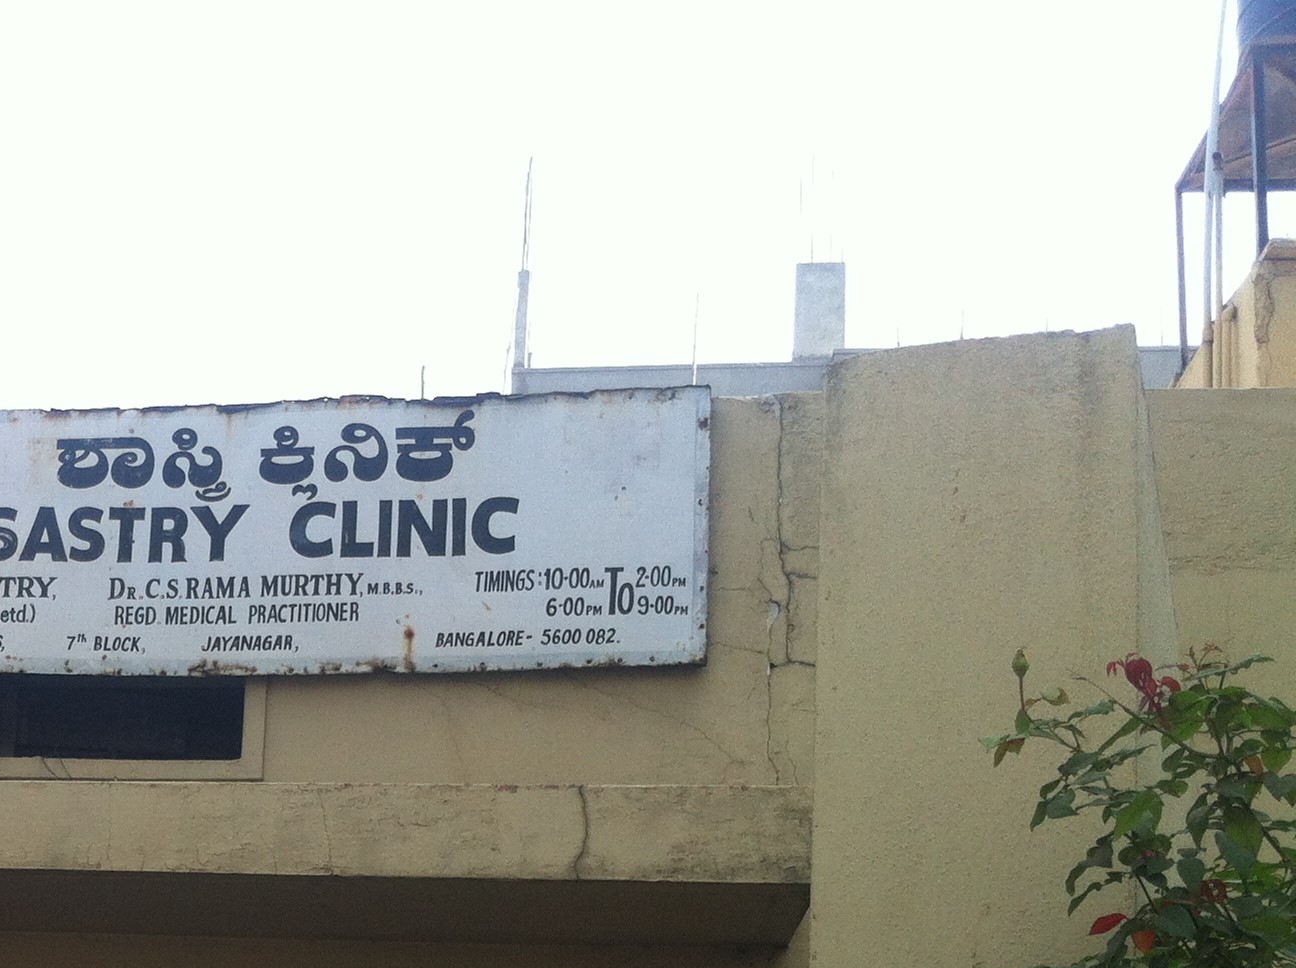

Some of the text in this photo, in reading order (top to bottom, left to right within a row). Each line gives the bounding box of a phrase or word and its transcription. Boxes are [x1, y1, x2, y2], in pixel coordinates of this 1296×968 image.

[289, 496, 520, 559] CLINIC
[165, 605, 237, 625] MEDICAL
[248, 602, 360, 624] PRACTITIONER
[93, 635, 146, 654] BLOCK,
[201, 635, 300, 653] JAYANAGAR,
